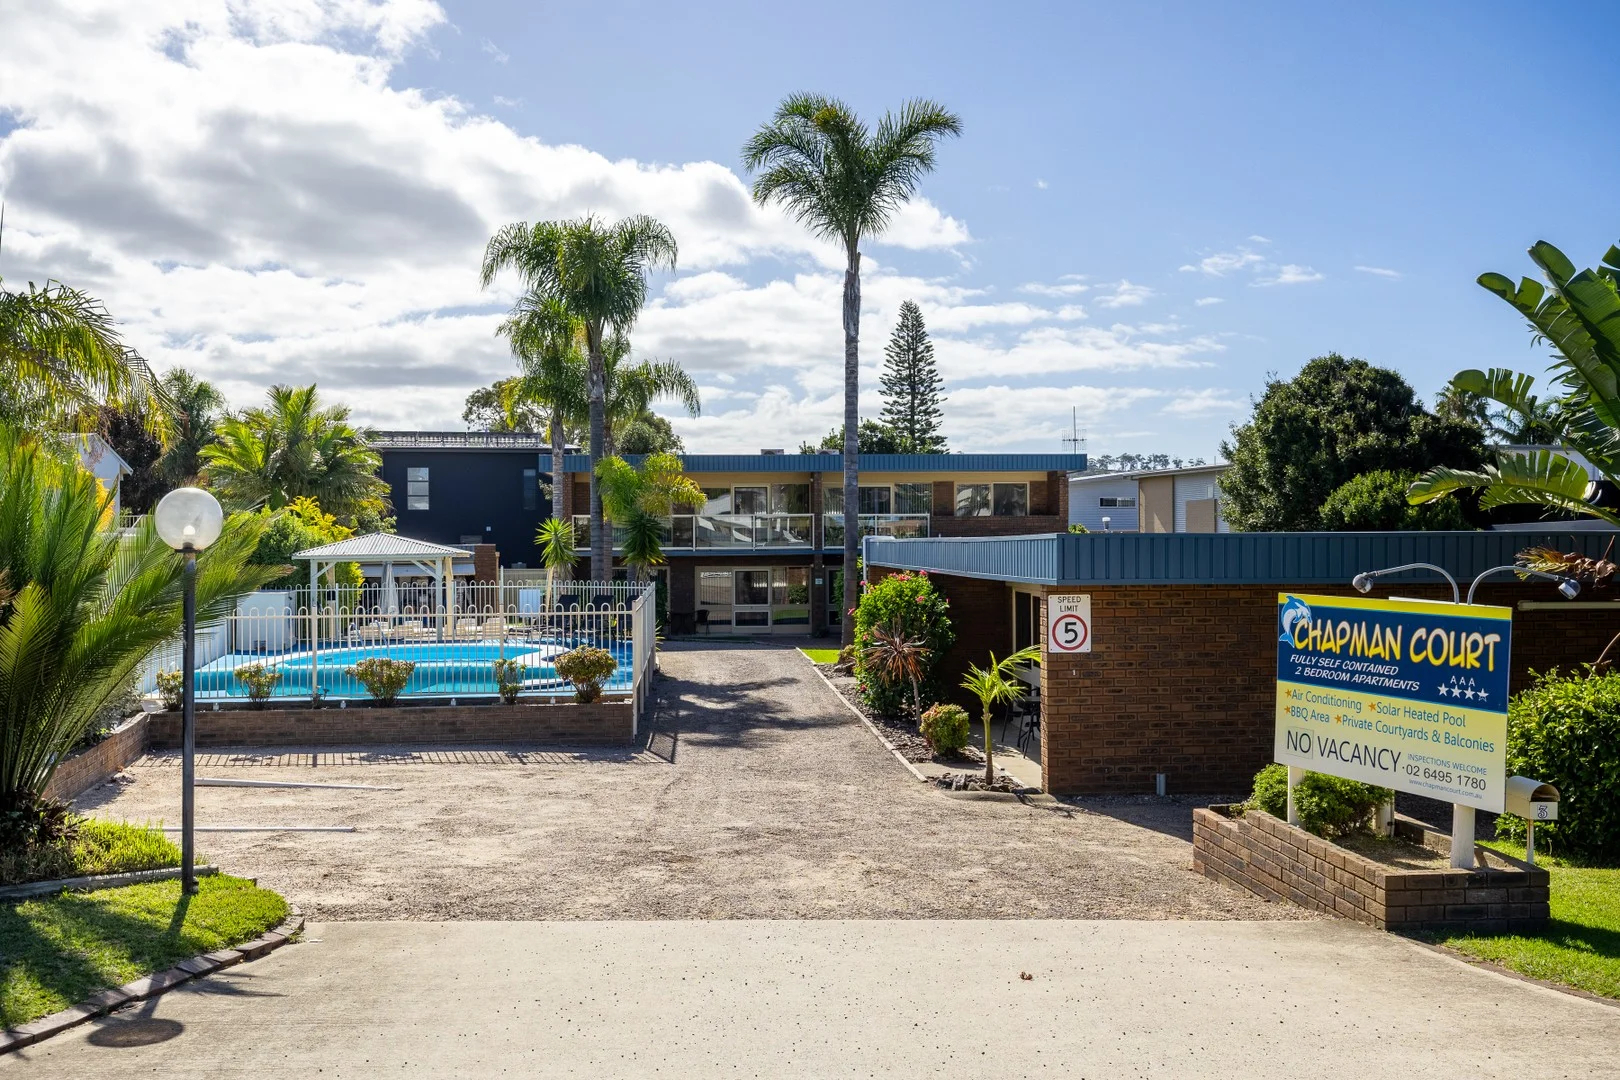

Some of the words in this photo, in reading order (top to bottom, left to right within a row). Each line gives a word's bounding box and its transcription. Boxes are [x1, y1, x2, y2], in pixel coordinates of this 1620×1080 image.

[1064, 621, 1079, 644] 5
[1294, 617, 1402, 661] CHAPMAN
[1409, 628, 1501, 672] COURT
[1290, 654, 1318, 665] FULLY
[1317, 657, 1341, 668] SELF
[1342, 660, 1399, 676] CONTAINED
[1295, 667, 1301, 675] 2
[1303, 668, 1350, 682] BEDROOM
[1351, 674, 1420, 691] APARTMENTS
[1291, 689, 1304, 701] Air
[1305, 690, 1363, 713] Conditioning
[1376, 701, 1401, 716] Solar
[1403, 706, 1440, 723] Heated
[1442, 712, 1466, 728] Pool
[1290, 705, 1309, 721] BBQ
[1310, 709, 1330, 723] Area
[1342, 714, 1372, 731] Private
[1375, 720, 1429, 741] Courtyards
[1432, 730, 1441, 743] &
[1444, 732, 1495, 753] Balconies
[1287, 729, 1312, 754] NO
[1317, 735, 1402, 772] VACANCY
[1407, 753, 1451, 769] INSPECTIONS
[1452, 762, 1487, 776] WELCOME
[1406, 764, 1420, 777] 02
[1423, 767, 1453, 784] 6495
[1456, 774, 1487, 791] 1780
[1408, 779, 1483, 800] www.chapmancourt.com.au
